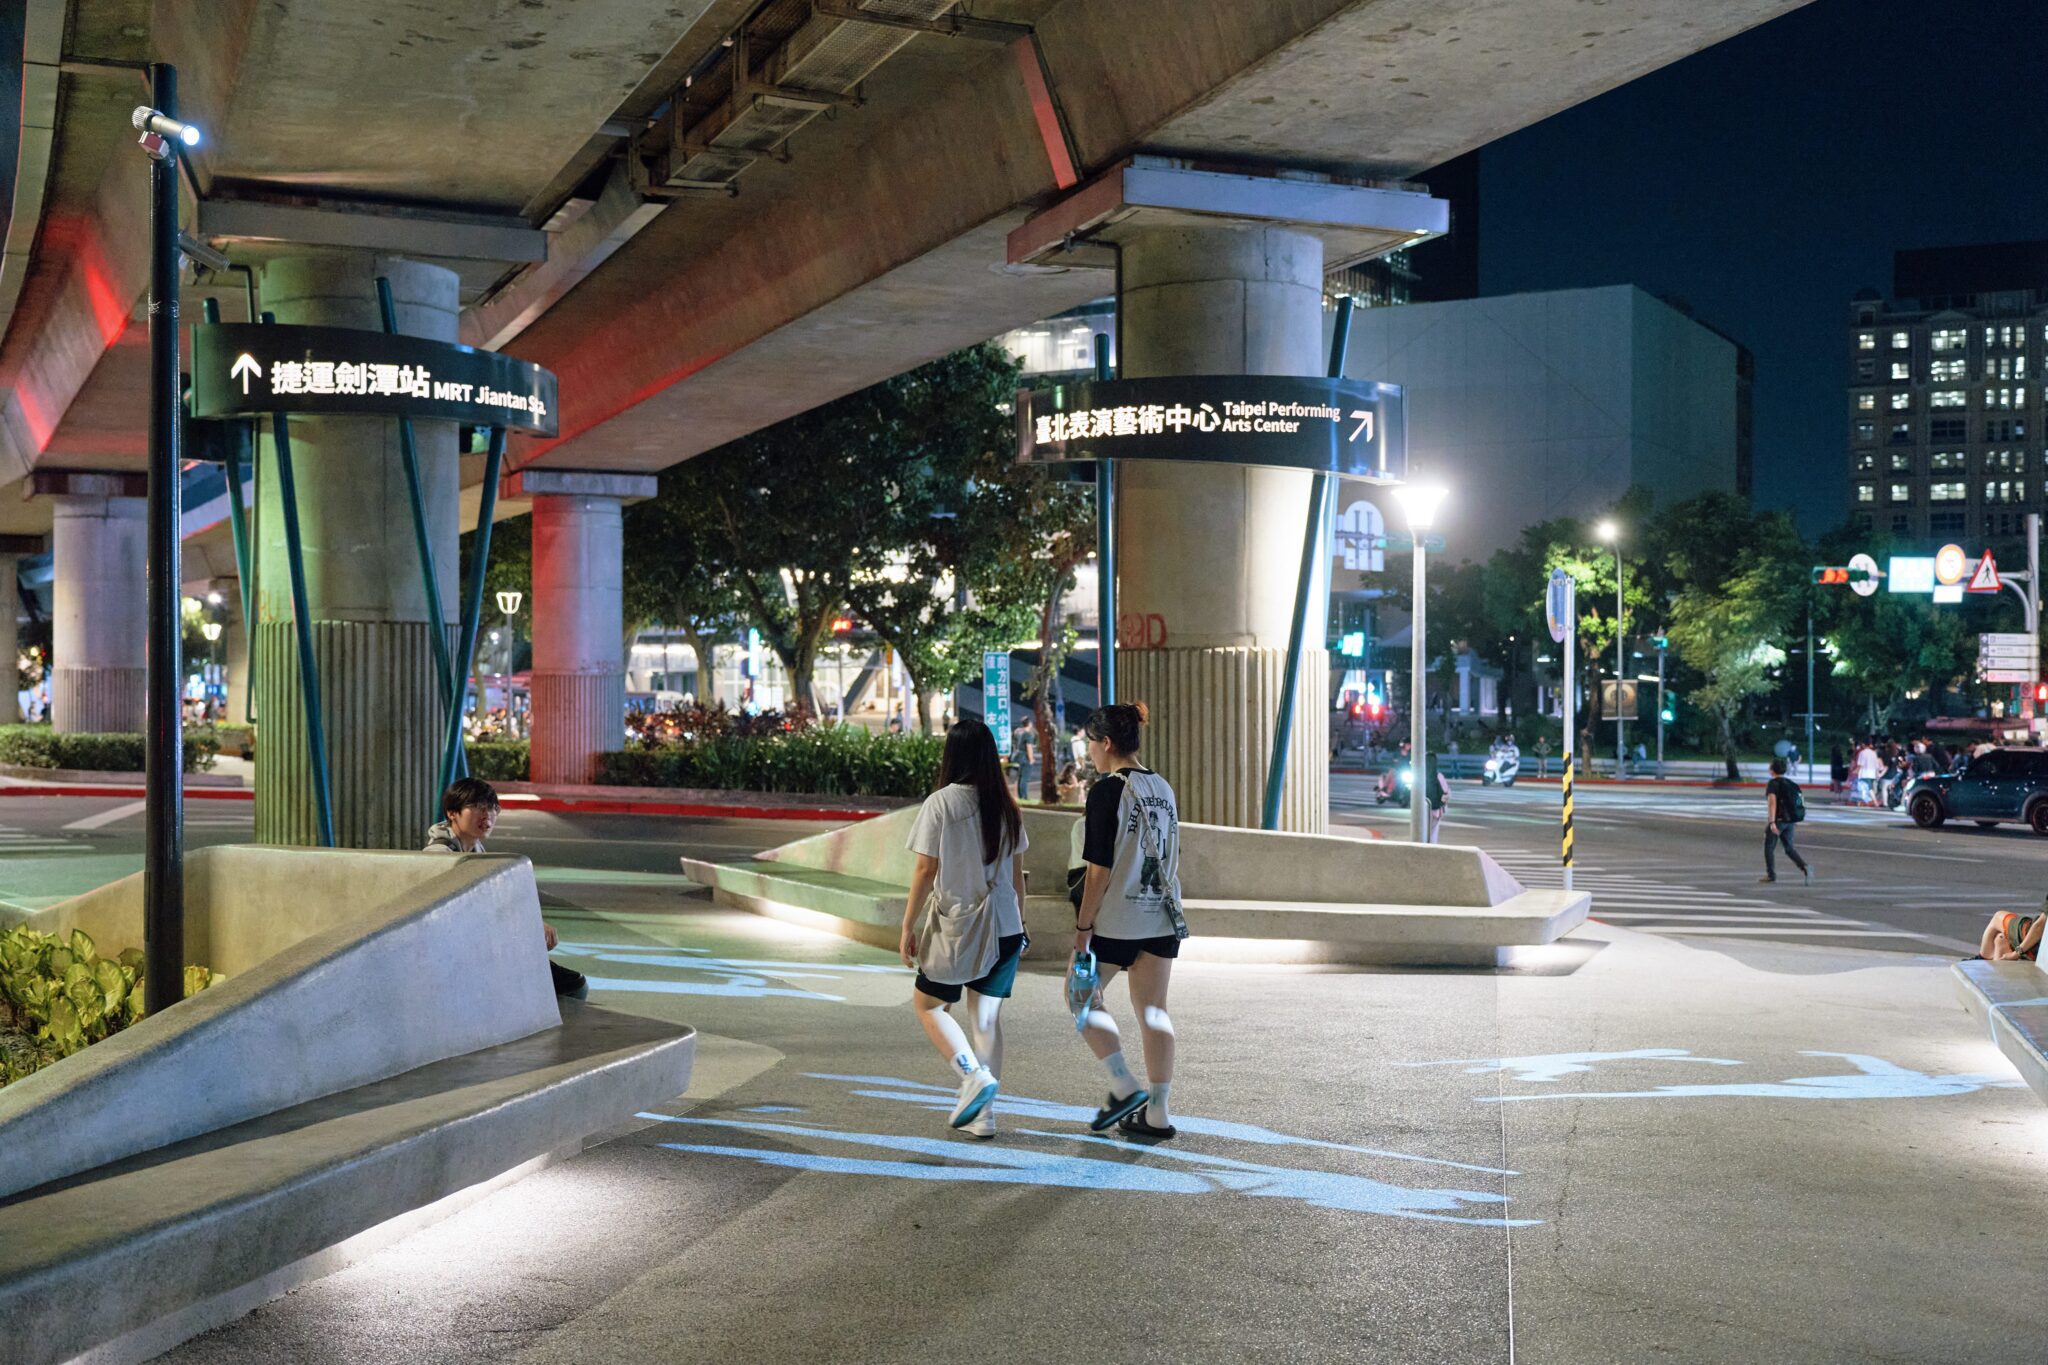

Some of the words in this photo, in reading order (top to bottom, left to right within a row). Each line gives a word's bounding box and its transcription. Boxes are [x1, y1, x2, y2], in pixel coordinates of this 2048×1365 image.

[271, 361, 431, 398] 捷運劍潭站
[434, 381, 473, 402] MRT
[475, 386, 527, 410] Jiantan
[528, 395, 547, 416] Sta.
[1222, 401, 1266, 417] Taipei
[1269, 401, 1341, 422] Performing
[1035, 403, 1221, 444] 臺北表演藝術中心
[1222, 418, 1251, 433] Arts
[1253, 418, 1300, 433] Center
